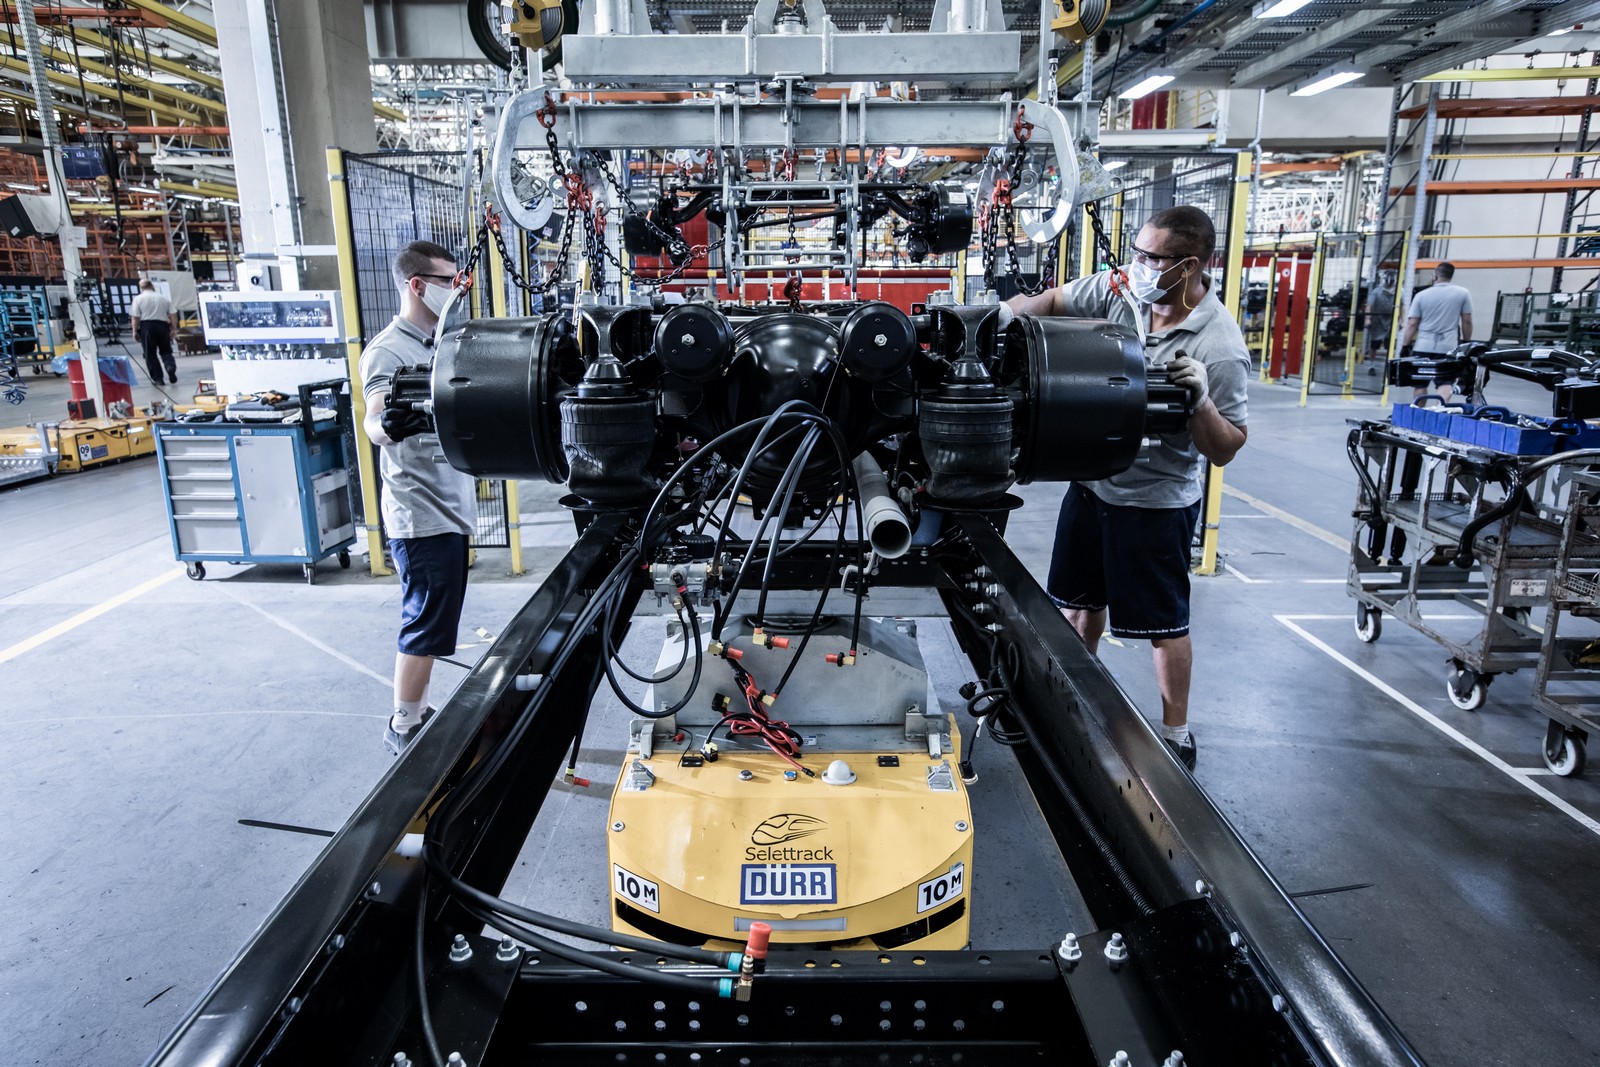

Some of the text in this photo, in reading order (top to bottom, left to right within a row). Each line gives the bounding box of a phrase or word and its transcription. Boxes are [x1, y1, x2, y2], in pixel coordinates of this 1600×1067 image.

[80, 445, 90, 454] 09
[745, 846, 834, 861] Selettrack
[750, 864, 827, 896] DÜRR
